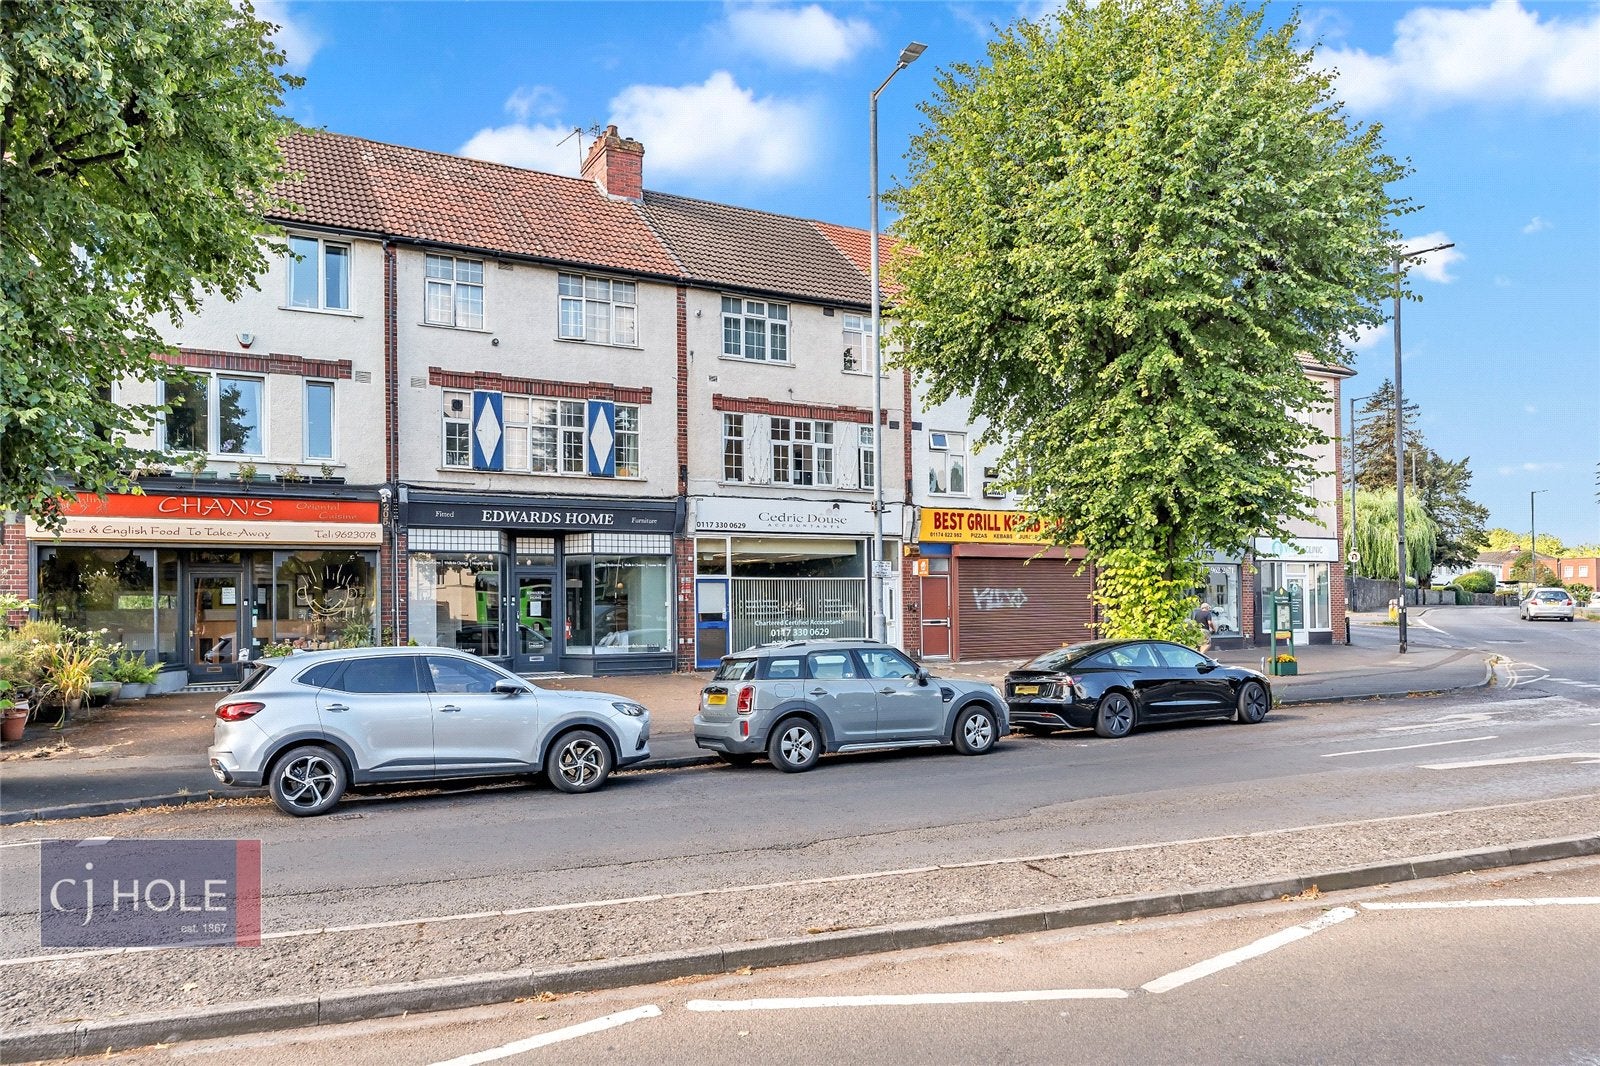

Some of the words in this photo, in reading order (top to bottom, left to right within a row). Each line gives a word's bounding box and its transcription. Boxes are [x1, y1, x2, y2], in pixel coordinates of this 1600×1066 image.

[158, 496, 273, 516] CHAN'S
[296, 502, 340, 511] Oriental
[435, 510, 455, 518] Fitted
[481, 509, 562, 524] EDWARDS
[564, 512, 614, 525] HOME
[758, 512, 804, 523] Cedric
[807, 514, 848, 525] Douse
[631, 516, 658, 524] Furniture
[715, 521, 728, 529] 330
[934, 511, 964, 530] BEST
[967, 513, 1001, 531] GRILL
[89, 525, 99, 534] &
[102, 525, 147, 537] English
[151, 526, 180, 536] Food
[186, 527, 202, 536] To
[204, 527, 271, 539] Take-Away
[754, 619, 784, 627] Chartered
[784, 619, 809, 627] Certified
[770, 628, 792, 638] 0117
[792, 628, 809, 637] 330
[809, 627, 830, 637] 0629
